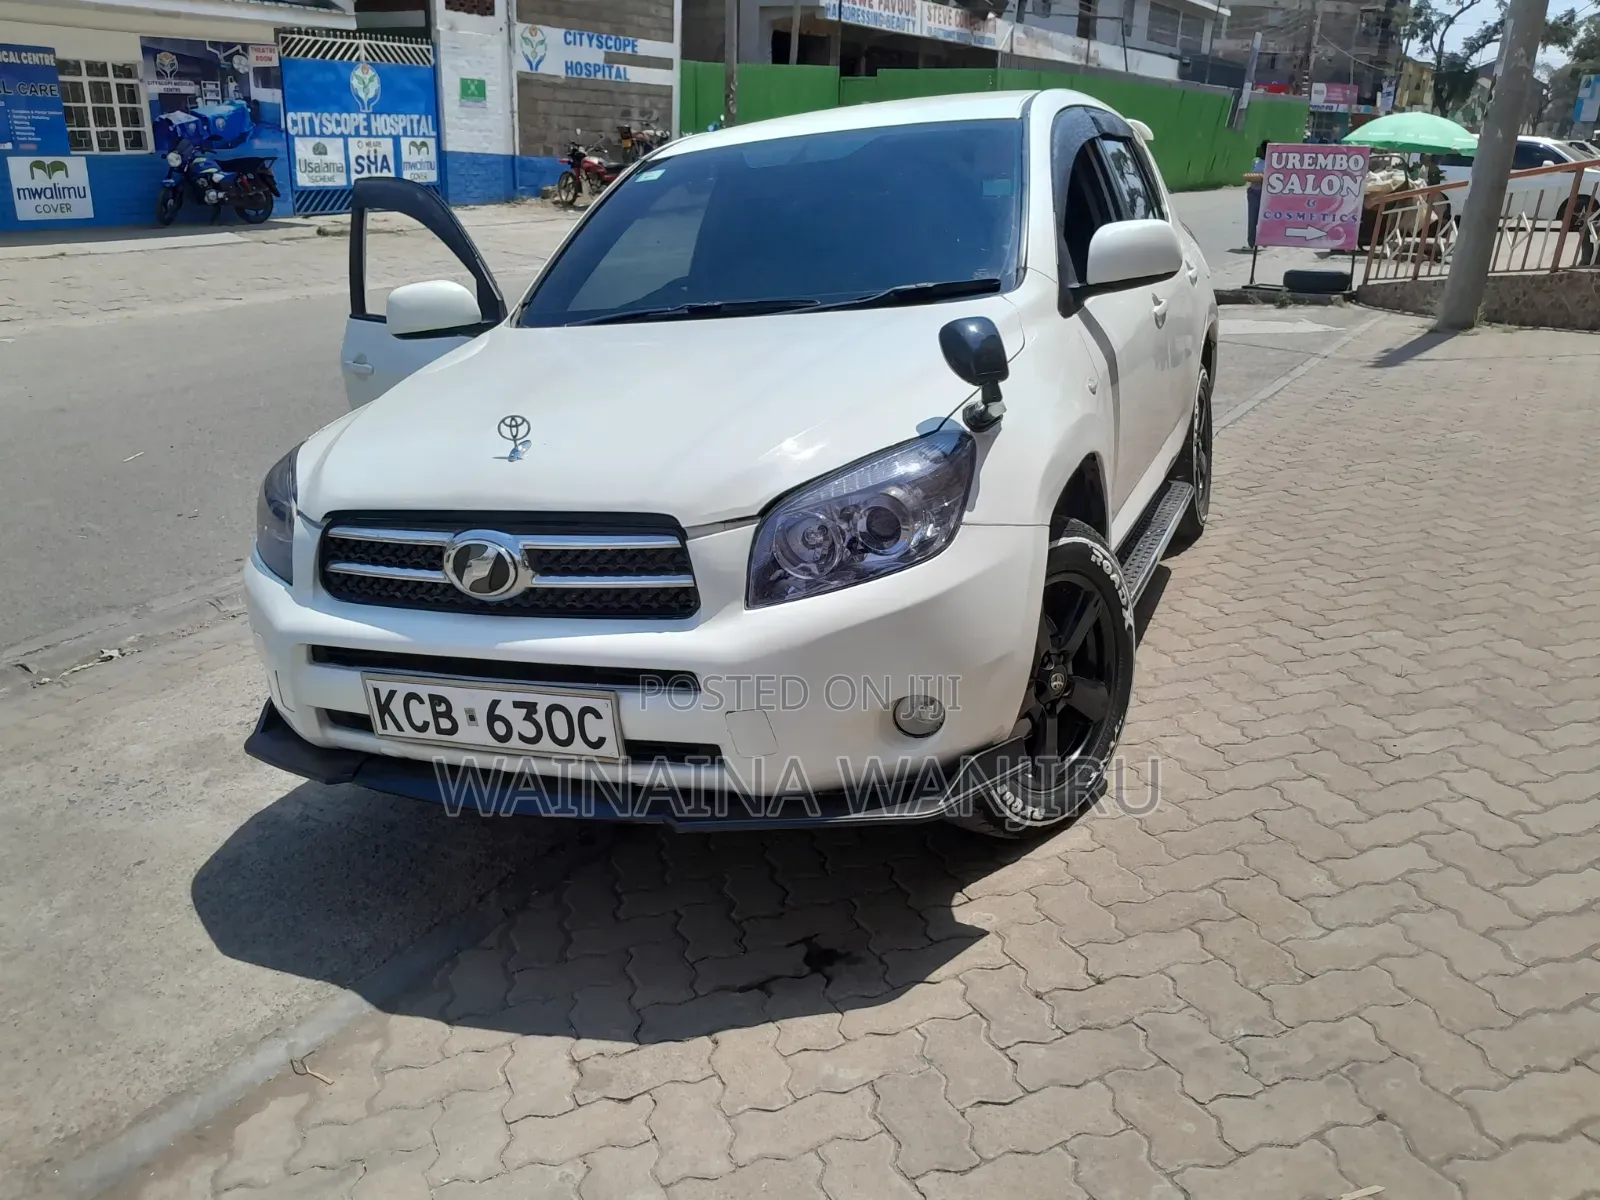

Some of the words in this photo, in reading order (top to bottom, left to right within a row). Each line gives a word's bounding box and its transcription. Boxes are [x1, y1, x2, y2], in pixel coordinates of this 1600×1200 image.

[926, 5, 953, 26] STEVE
[563, 30, 639, 54] CITYSCOPE
[21, 52, 56, 66] CENTRE
[564, 60, 631, 82] HOSPITAL
[17, 81, 59, 97] CARE
[286, 111, 368, 136] CITYSCOPE
[370, 113, 437, 137] HOSPITAL
[298, 158, 344, 174] Usalama
[354, 151, 392, 175] SHA
[1271, 152, 1365, 171] UREMBO
[16, 182, 87, 201] mwalimu
[1267, 172, 1364, 197] SALON
[35, 202, 73, 214] COVER
[1263, 210, 1358, 222] COSMETICS
[372, 687, 459, 737] KCB
[486, 699, 607, 750] 630C
